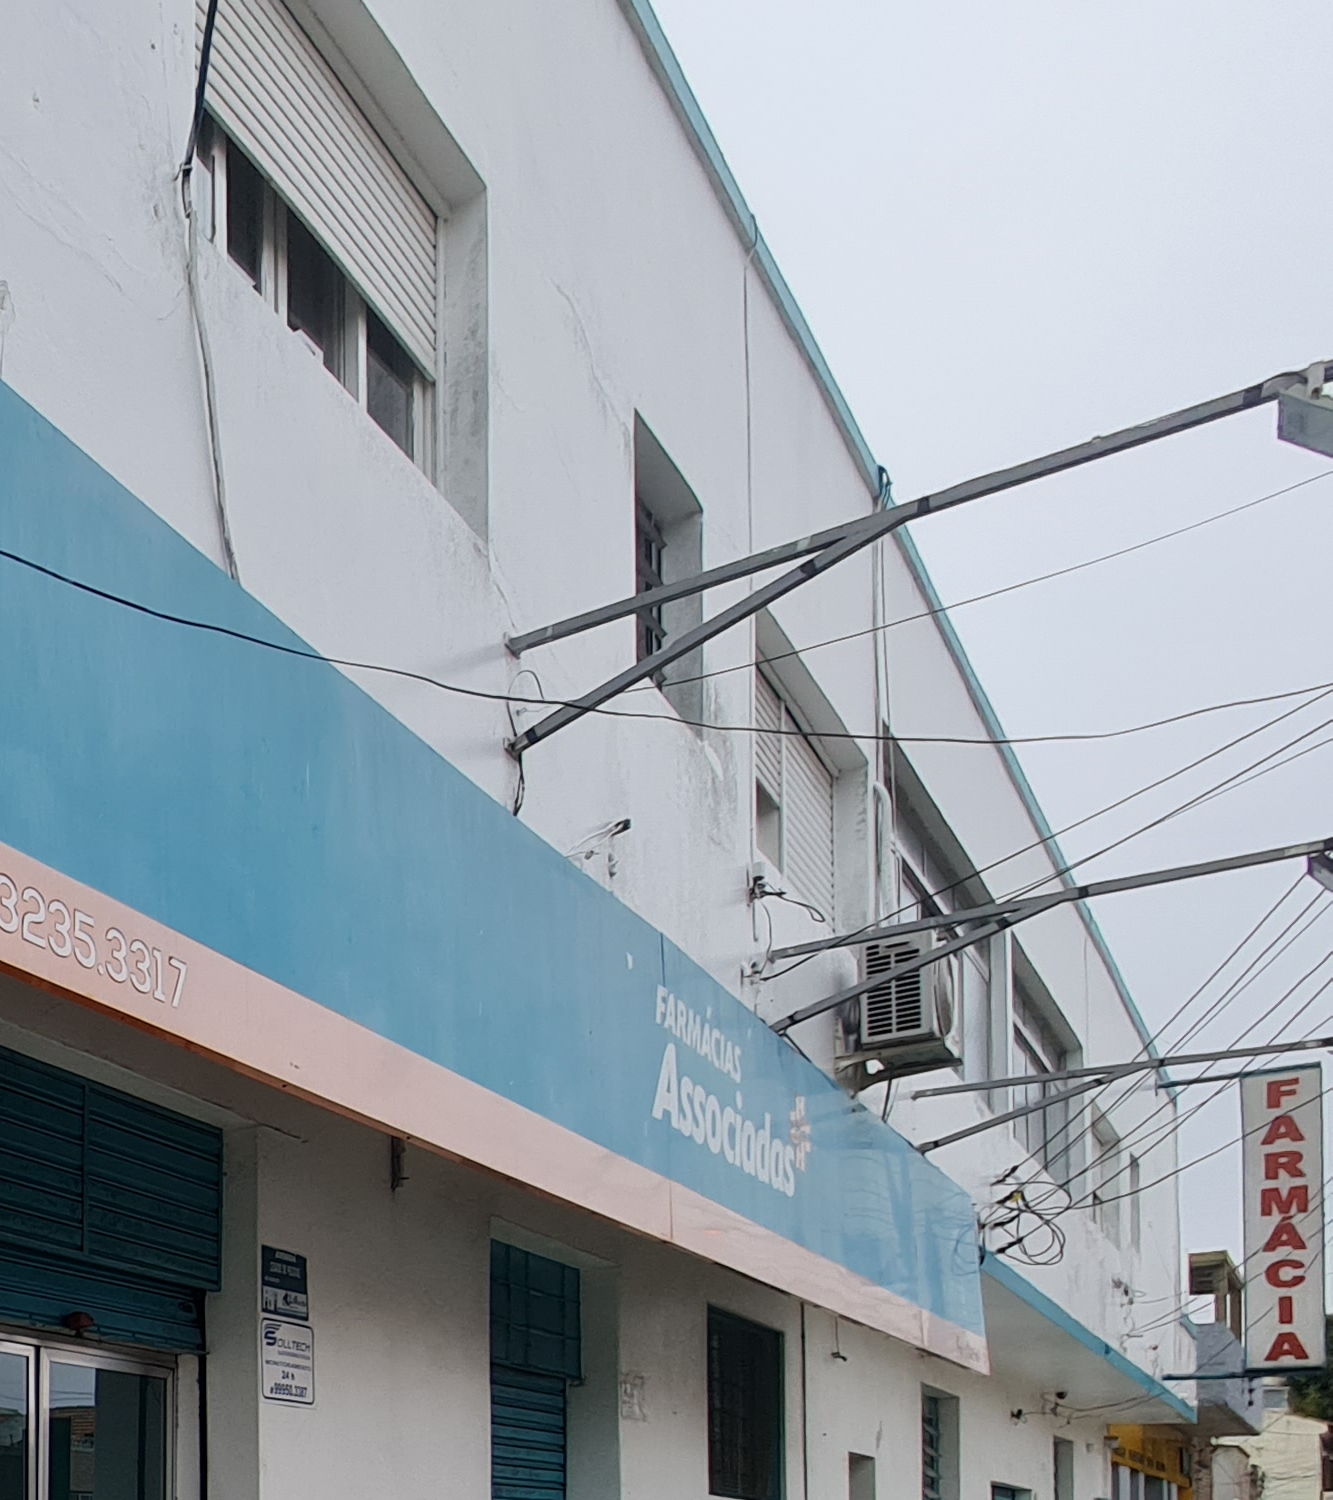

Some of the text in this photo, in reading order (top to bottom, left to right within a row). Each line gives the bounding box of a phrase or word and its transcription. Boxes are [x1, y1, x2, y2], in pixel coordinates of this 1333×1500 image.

[655, 984, 742, 1084] FARMÁCIAS
[652, 1042, 795, 1198] Associadas
[1260, 1076, 1310, 1362] FARMÁCIA
